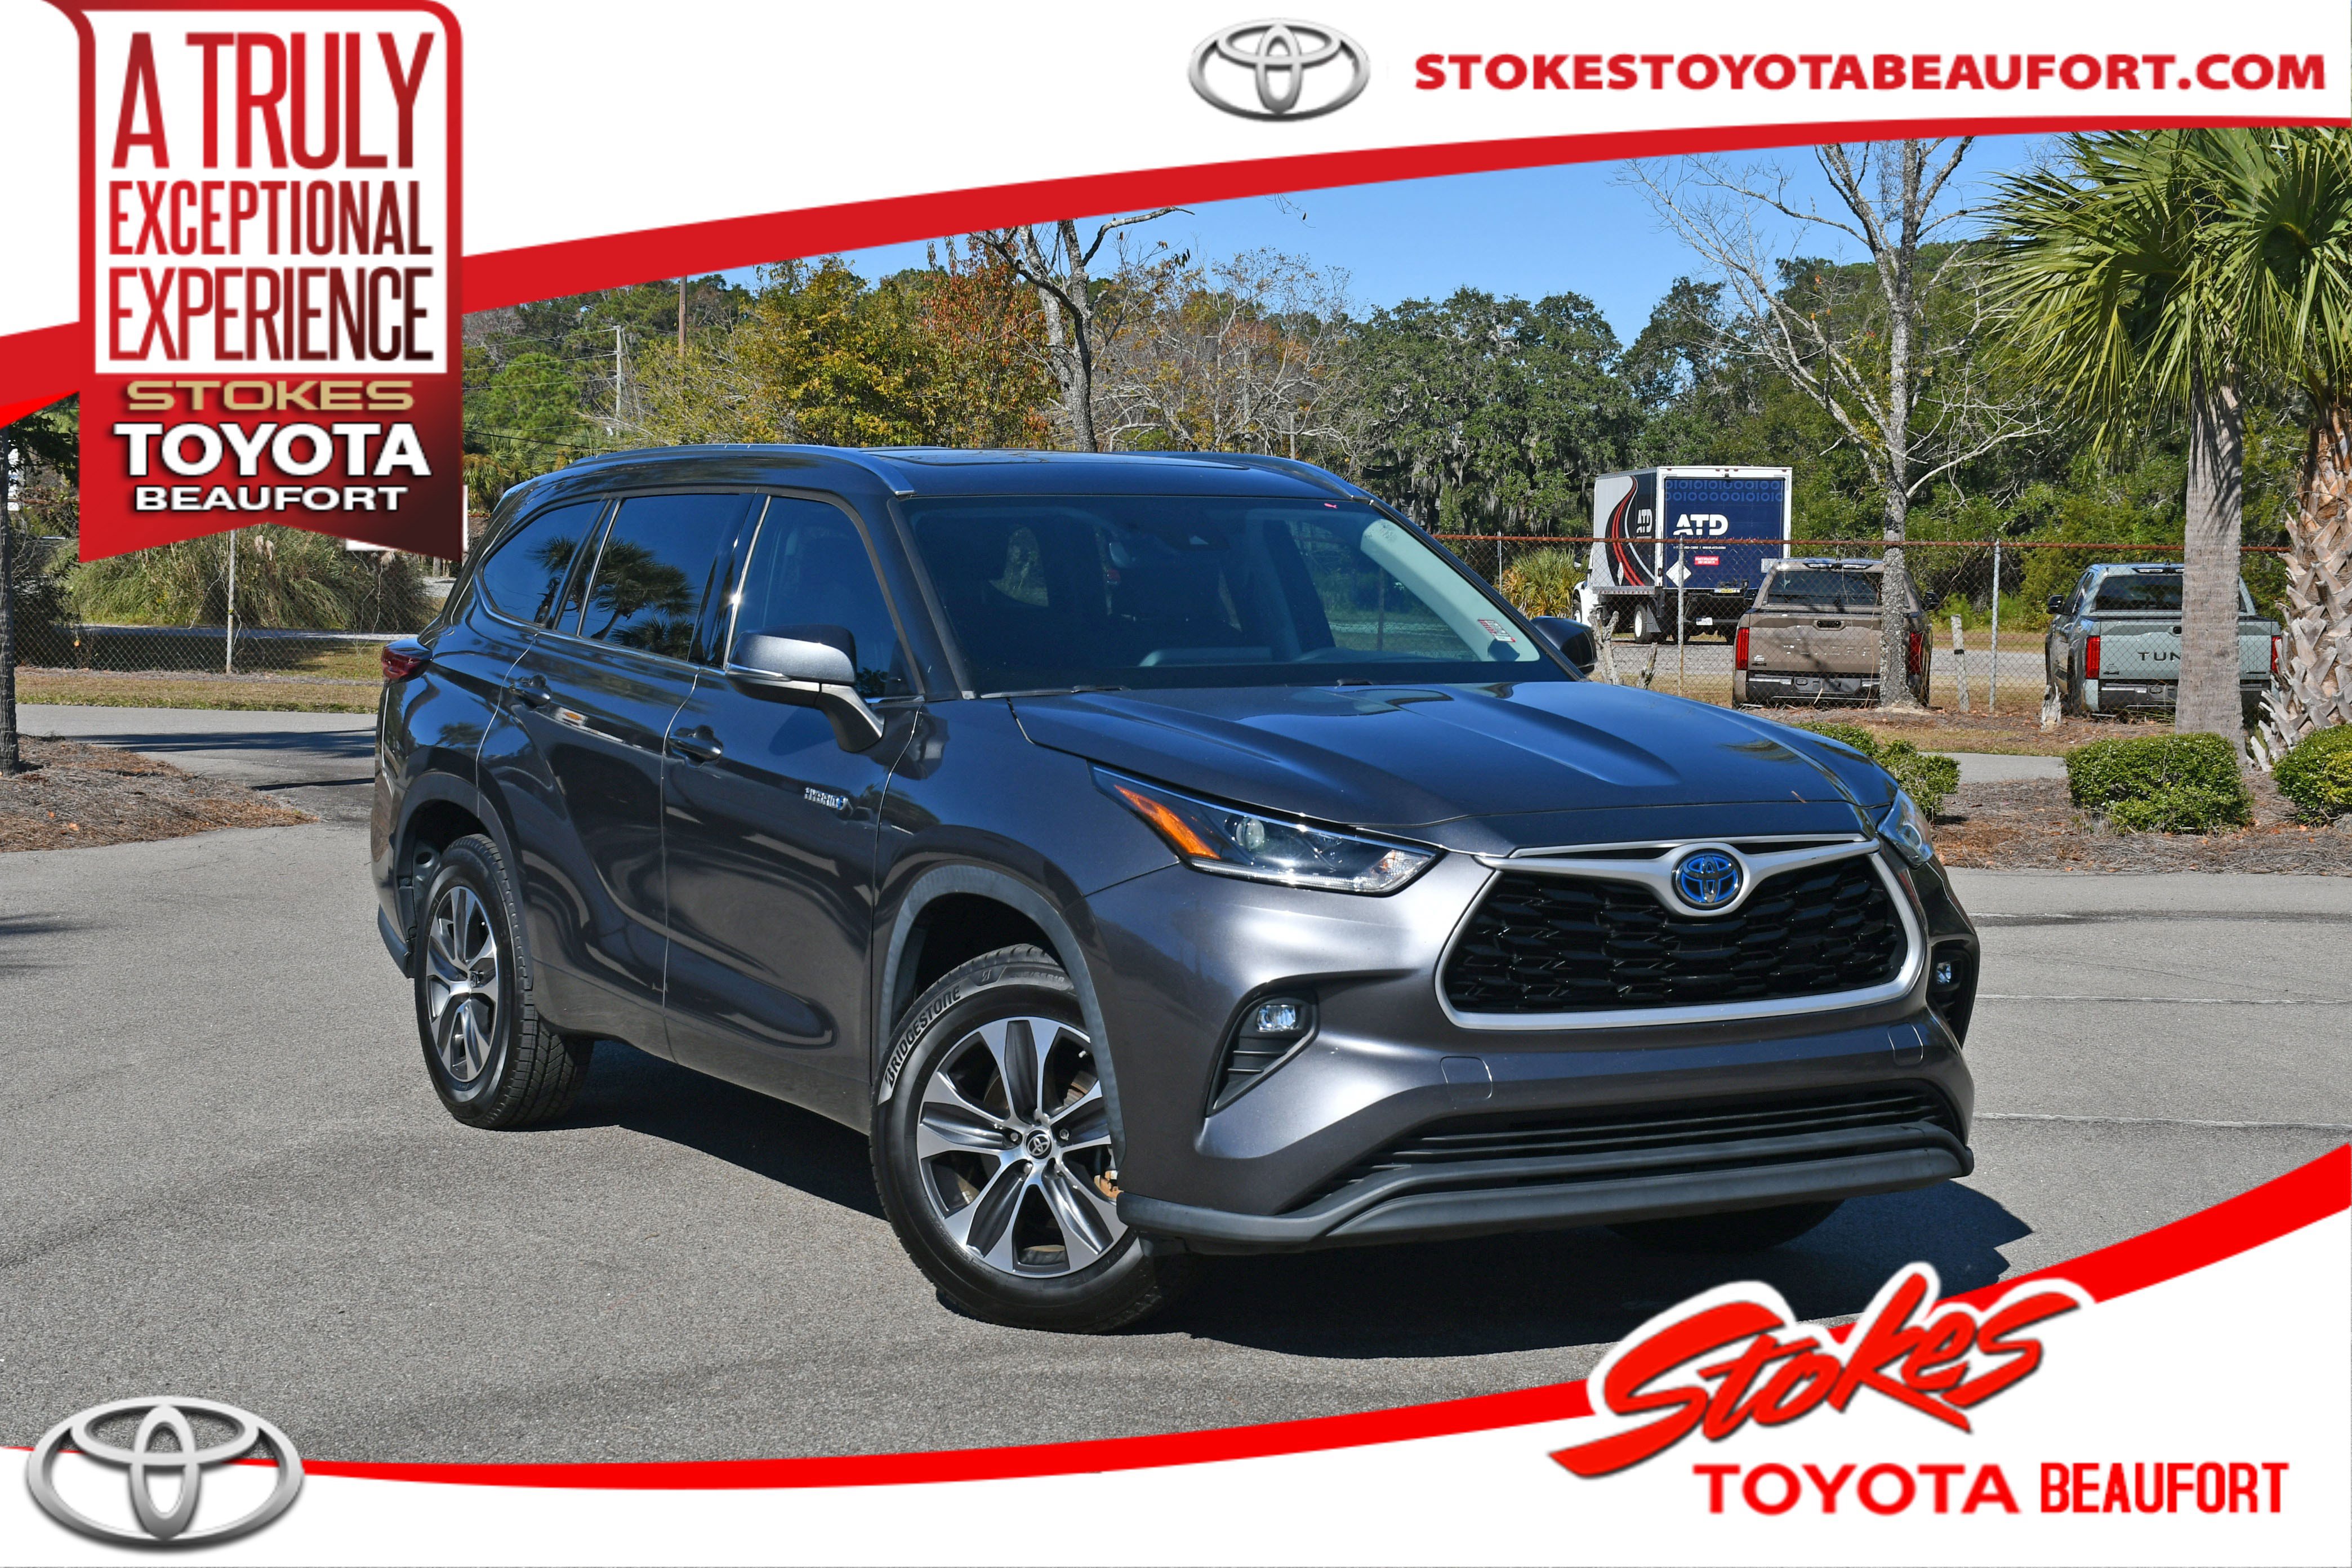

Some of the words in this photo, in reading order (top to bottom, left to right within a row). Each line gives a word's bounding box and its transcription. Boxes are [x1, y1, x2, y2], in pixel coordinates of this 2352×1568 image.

[1636, 509, 1652, 533] ATD
[1673, 514, 1729, 535] ATD
[804, 787, 838, 809] HYBRID
[885, 985, 961, 1088] BRIDGESTONE
